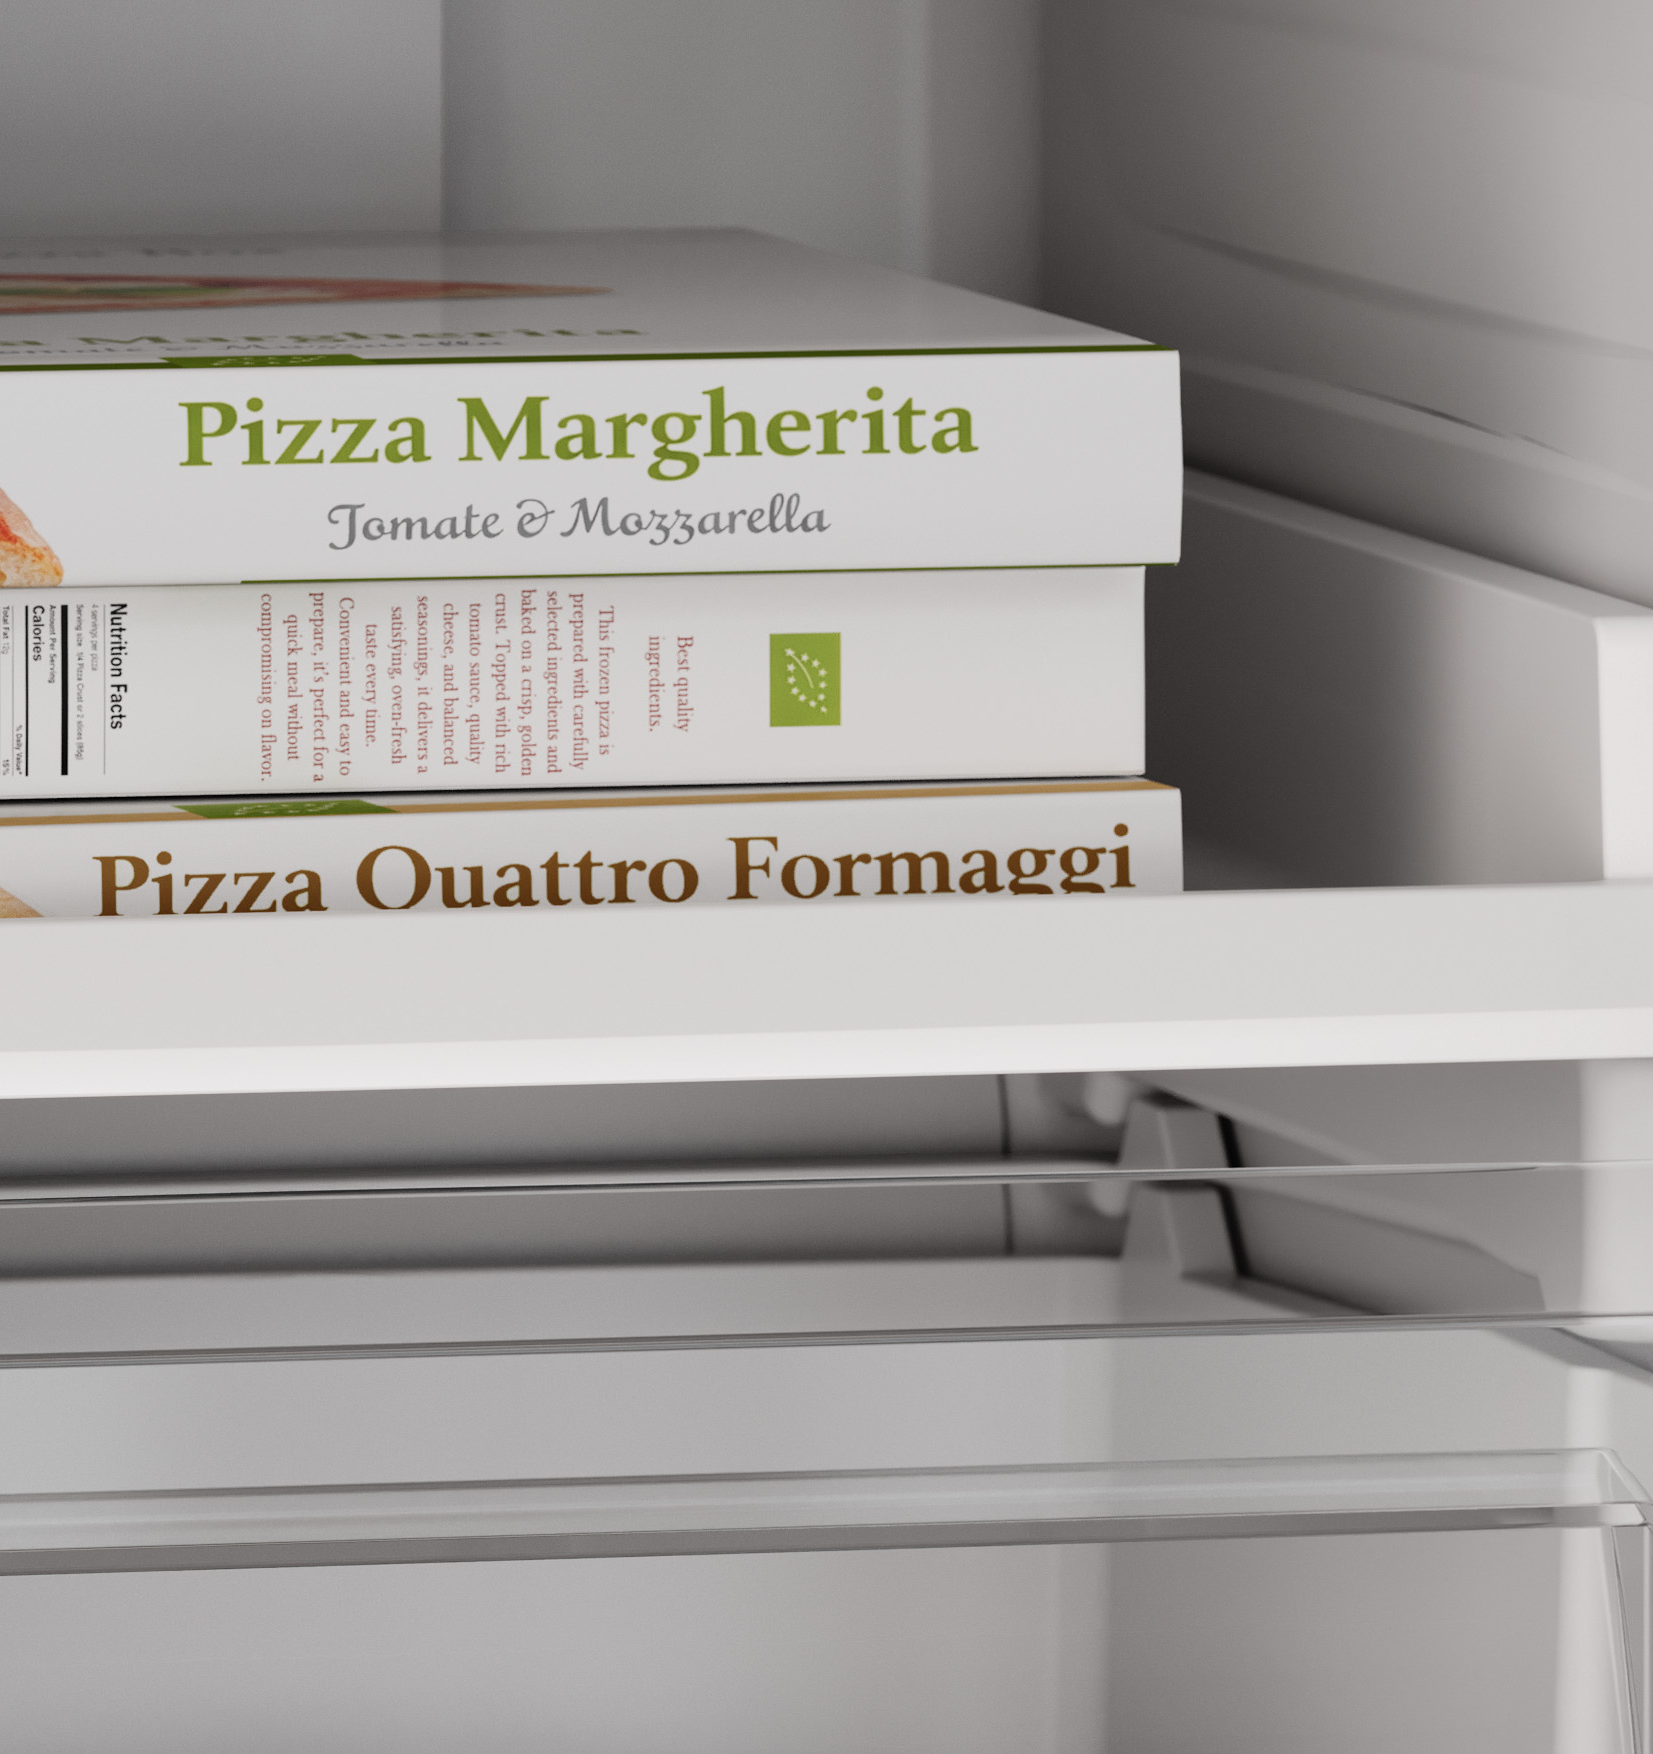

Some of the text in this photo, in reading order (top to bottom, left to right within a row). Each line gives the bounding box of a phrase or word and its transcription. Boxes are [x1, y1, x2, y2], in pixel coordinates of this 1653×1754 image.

[178, 386, 979, 481] Pizza Margherita
[328, 493, 831, 550] Tomate & Mozzarella
[33, 606, 45, 661] Calories
[110, 604, 128, 729] Nutrition Facts
[308, 592, 324, 656] prepare,
[414, 596, 432, 680] seasonings,
[258, 594, 277, 781] compromising on flavor.
[283, 614, 303, 760] quick meal without
[310, 688, 329, 742] perfect
[336, 597, 354, 776] Convenient and easy to
[362, 624, 380, 746] taste every time.
[388, 607, 407, 764] satisfying, oven-fresh
[418, 687, 432, 696] it
[418, 702, 433, 760] delivers
[442, 603, 459, 765] cheese, and balanced
[466, 603, 485, 764] tomato sauce, quality
[491, 593, 511, 772] crust. Topped with rich
[517, 589, 537, 776] baked on a crisp, golden
[544, 591, 562, 773] selected ingredients and
[568, 593, 588, 769] prepared with carefully
[595, 606, 614, 755] This frozen pizza is
[645, 637, 665, 731] ingredients.
[673, 636, 694, 731] Best quality
[314, 747, 329, 768] for
[314, 774, 324, 782] a
[92, 823, 1136, 917] Pizza Quattro Formaggi
